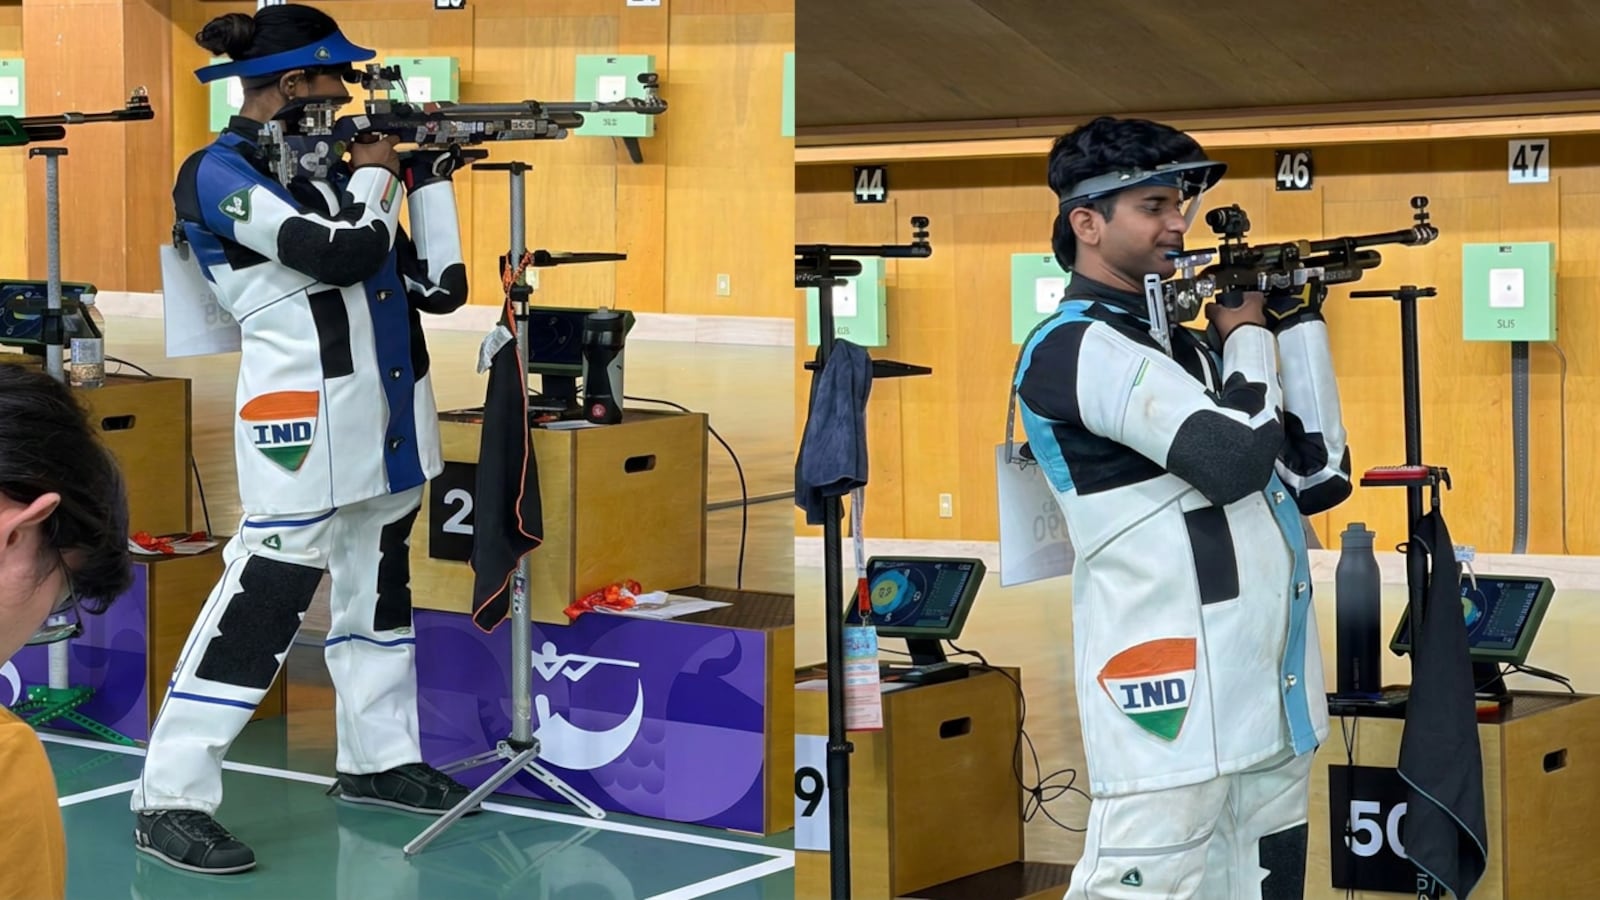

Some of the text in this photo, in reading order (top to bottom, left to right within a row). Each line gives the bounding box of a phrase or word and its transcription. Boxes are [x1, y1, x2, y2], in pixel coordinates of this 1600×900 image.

[1277, 152, 1309, 188] 46
[1512, 144, 1545, 178] 47
[856, 169, 884, 201] 44
[253, 421, 311, 445] IND
[442, 488, 474, 535] 2
[1120, 678, 1187, 710] IND
[795, 766, 825, 817] 9
